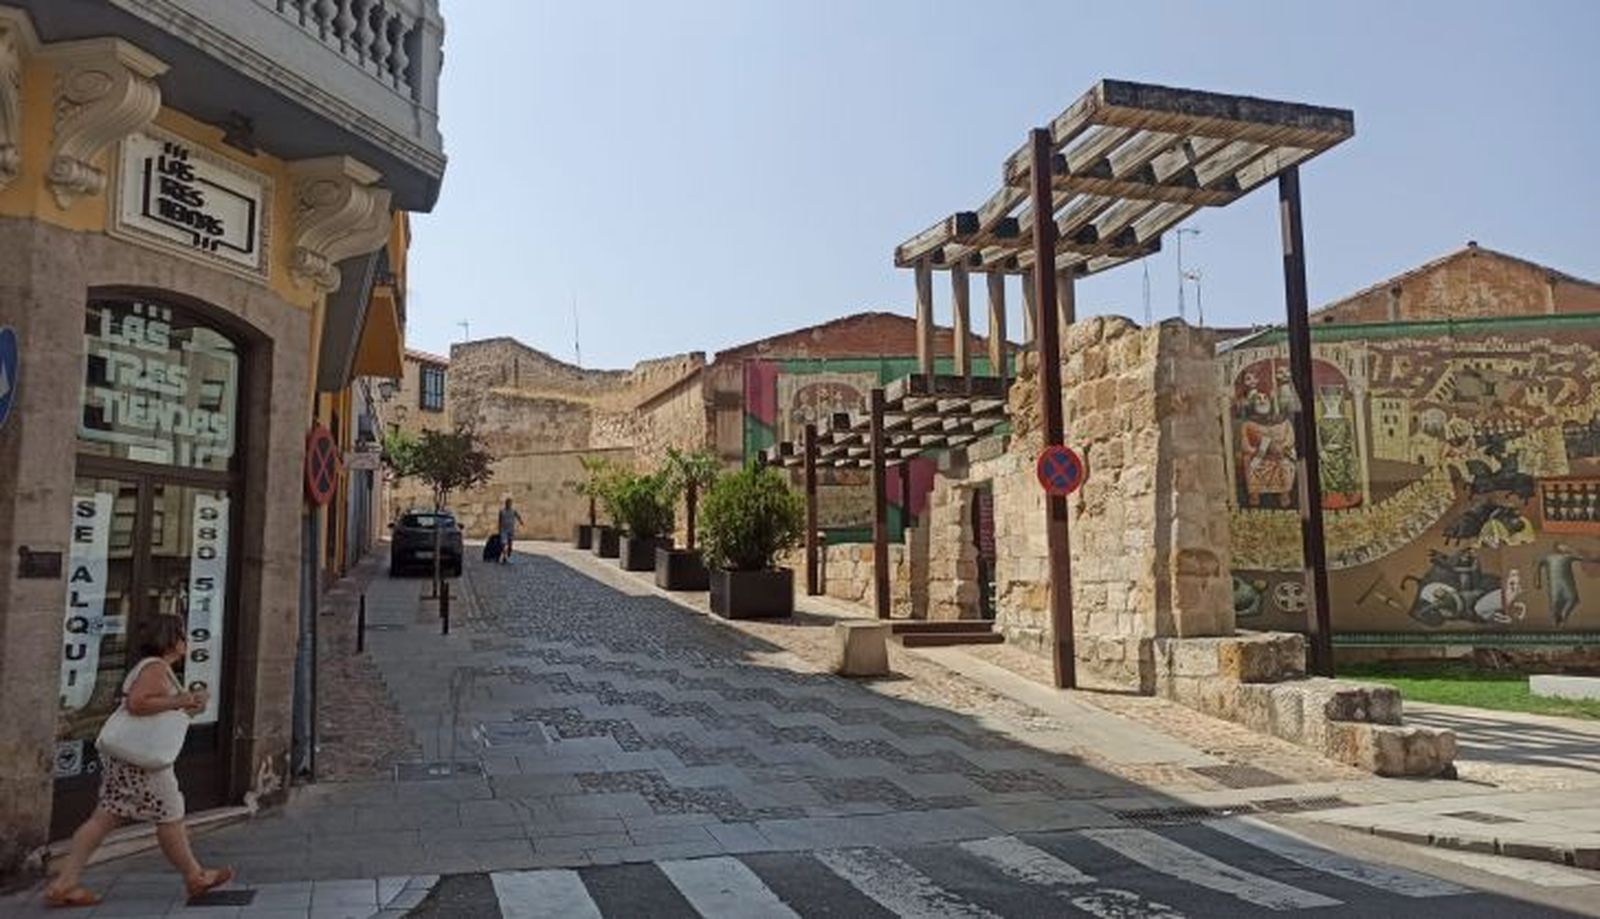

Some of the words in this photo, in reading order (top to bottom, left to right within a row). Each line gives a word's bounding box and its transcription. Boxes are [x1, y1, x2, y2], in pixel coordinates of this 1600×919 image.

[158, 155, 195, 182] LAS
[159, 176, 204, 207] TRES
[157, 198, 224, 236] TIENDAS
[100, 308, 170, 353] LAS
[98, 348, 188, 396] TRES
[94, 386, 229, 440] TIENDAS
[74, 500, 96, 544] SE
